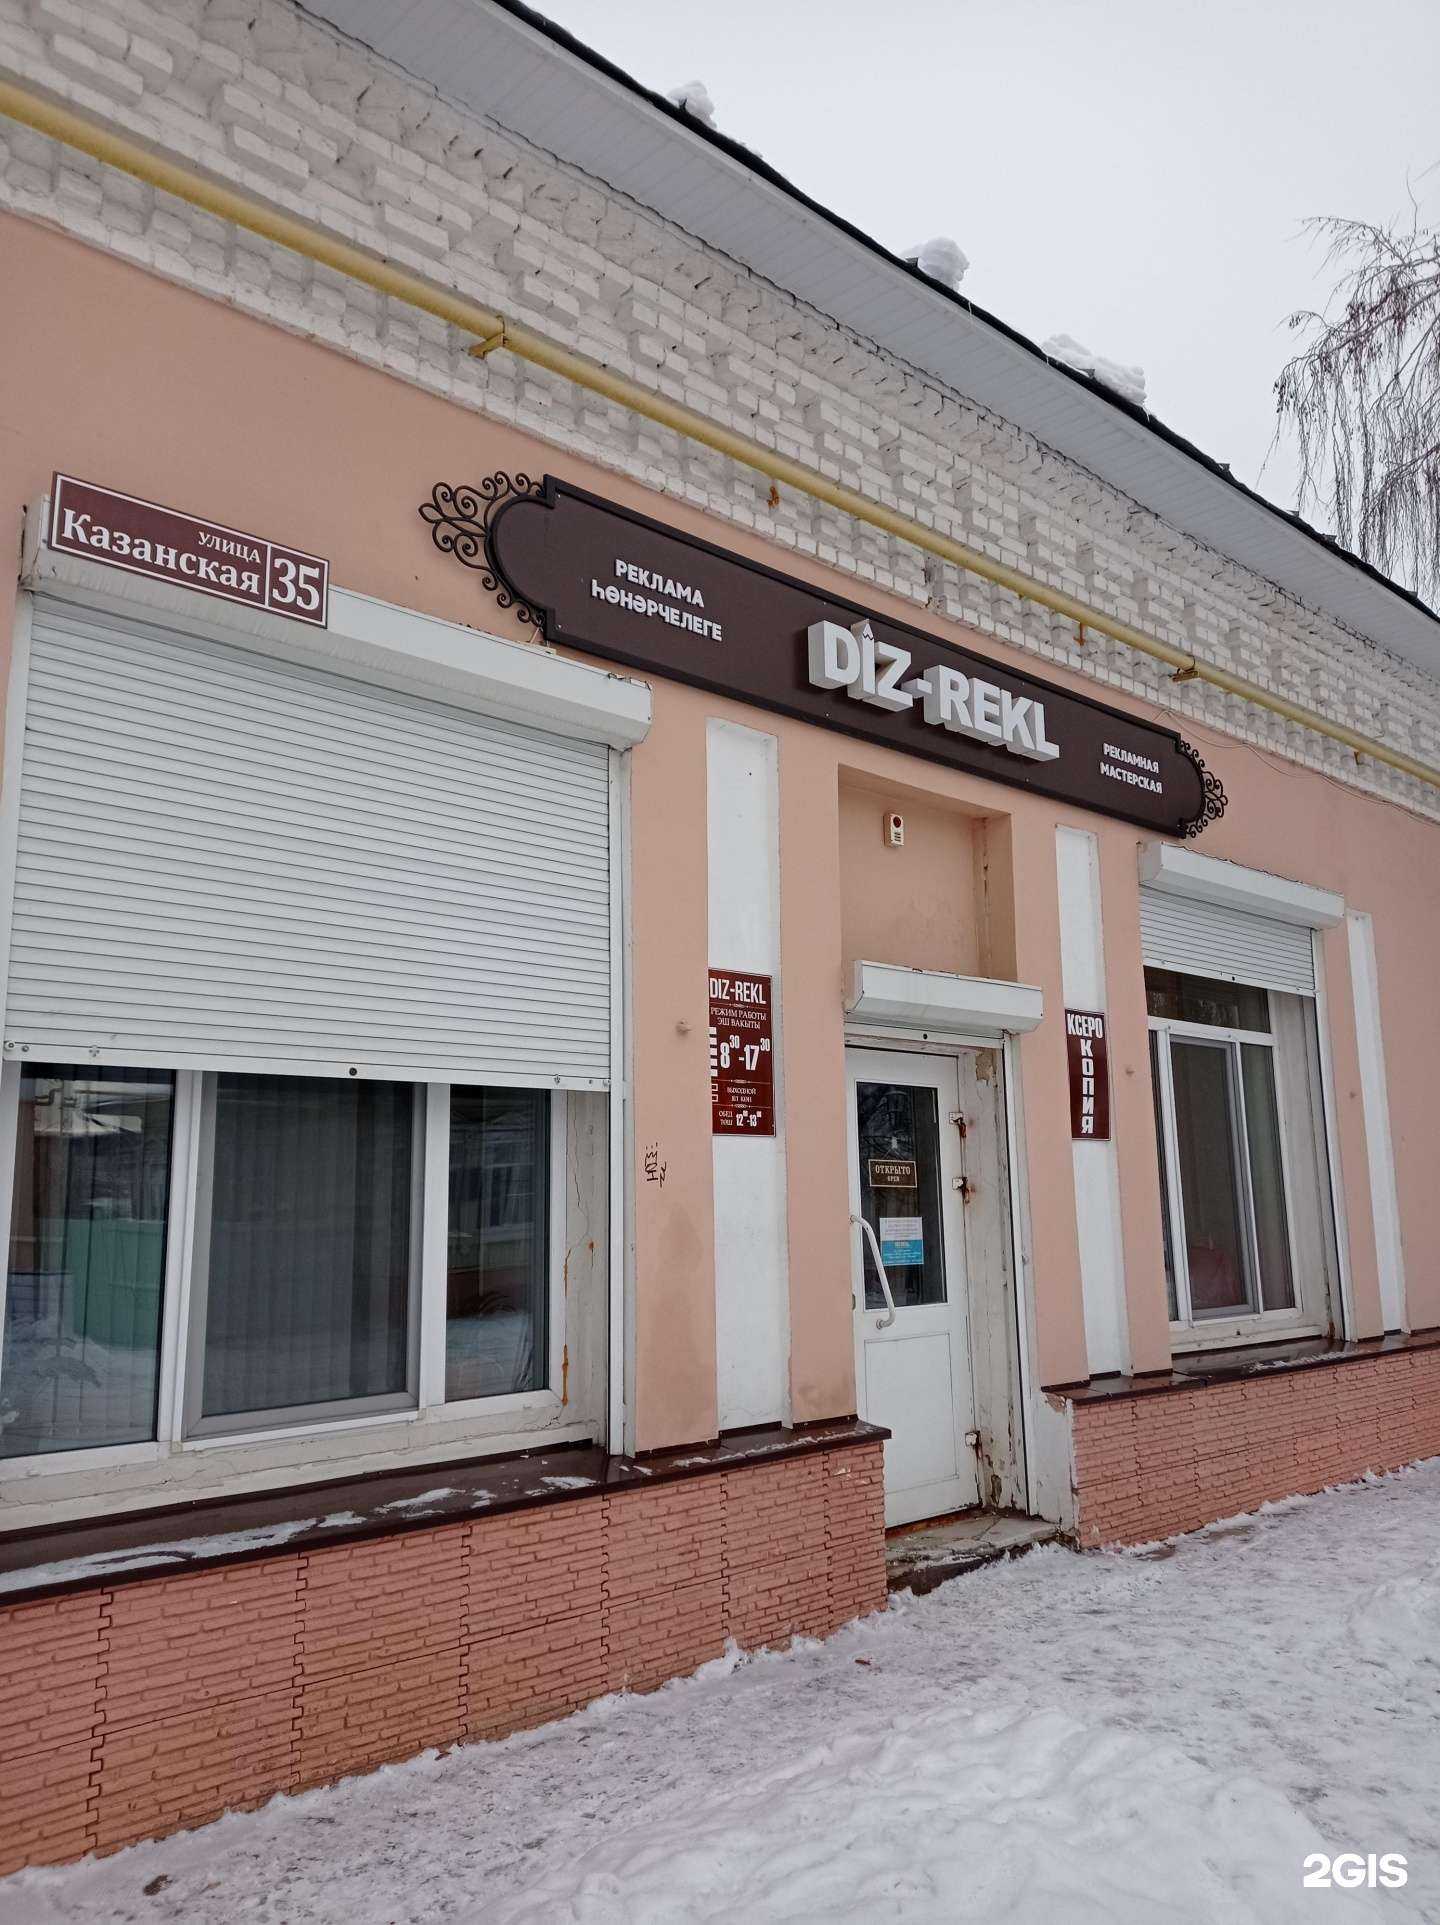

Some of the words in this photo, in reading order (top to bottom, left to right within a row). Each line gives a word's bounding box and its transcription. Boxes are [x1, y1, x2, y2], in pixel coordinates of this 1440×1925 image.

[61, 507, 261, 596] Казанская
[271, 557, 321, 611] 35
[198, 531, 262, 563] УЛИЦА
[615, 558, 705, 608] РЕКЛАМА
[1103, 742, 1160, 774] РЕКЛАМНАЯ
[1099, 761, 1163, 794] МАСТЕРСКАЯ
[709, 977, 767, 1005] DIZ-REKL
[710, 1006, 738, 1018] РЕЖИМ
[738, 1009, 767, 1021] РАБОТЫ
[730, 1018, 761, 1030] ВАКЫТЫ
[1067, 1013, 1104, 1039] КСЕРО
[1080, 1038, 1095, 1134] КОПИЯ
[875, 1164, 911, 1175] ОТКРЫТО
